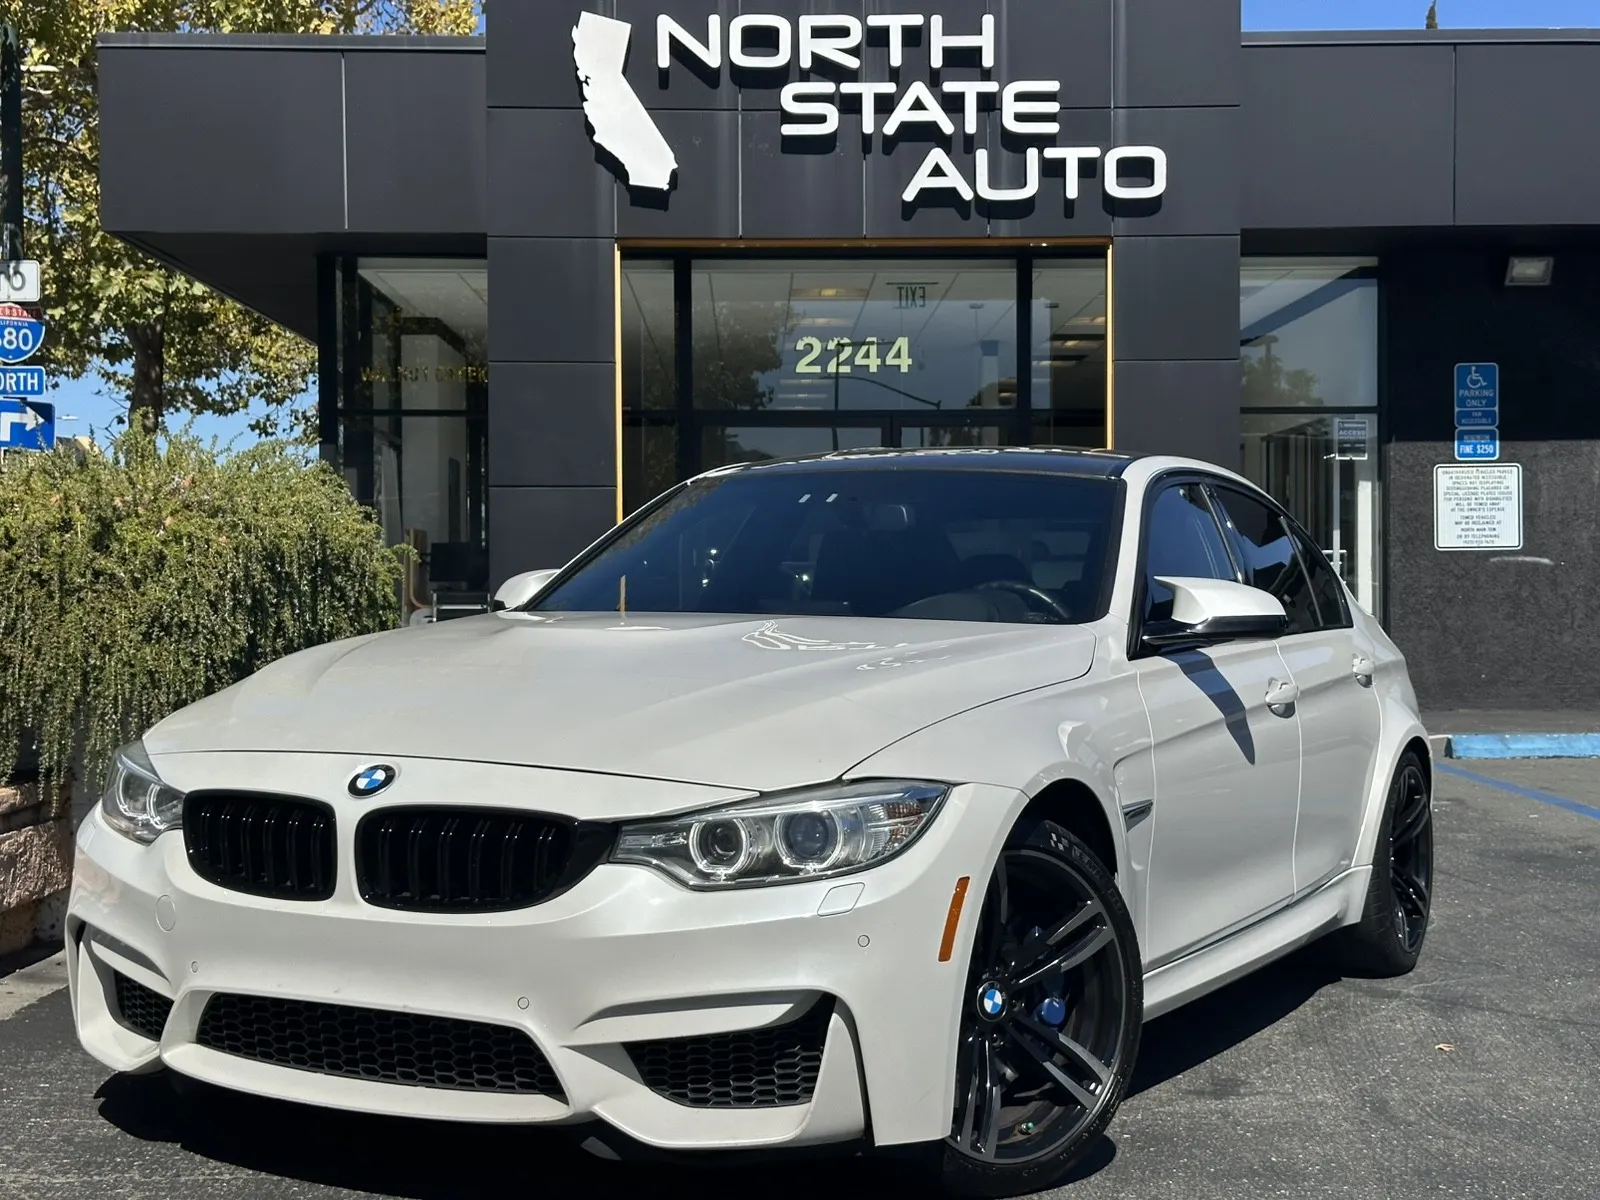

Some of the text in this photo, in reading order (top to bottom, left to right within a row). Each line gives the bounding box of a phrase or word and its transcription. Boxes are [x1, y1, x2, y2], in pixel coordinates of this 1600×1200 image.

[656, 14, 995, 69] NORTH
[780, 80, 1061, 136] STATE
[902, 145, 1167, 202] AUTO
[0, 326, 33, 352] 80
[795, 336, 913, 373] 2244
[1459, 389, 1495, 397] PARKING
[1465, 399, 1487, 407] ONLY
[1459, 444, 1494, 454] FINE $250
